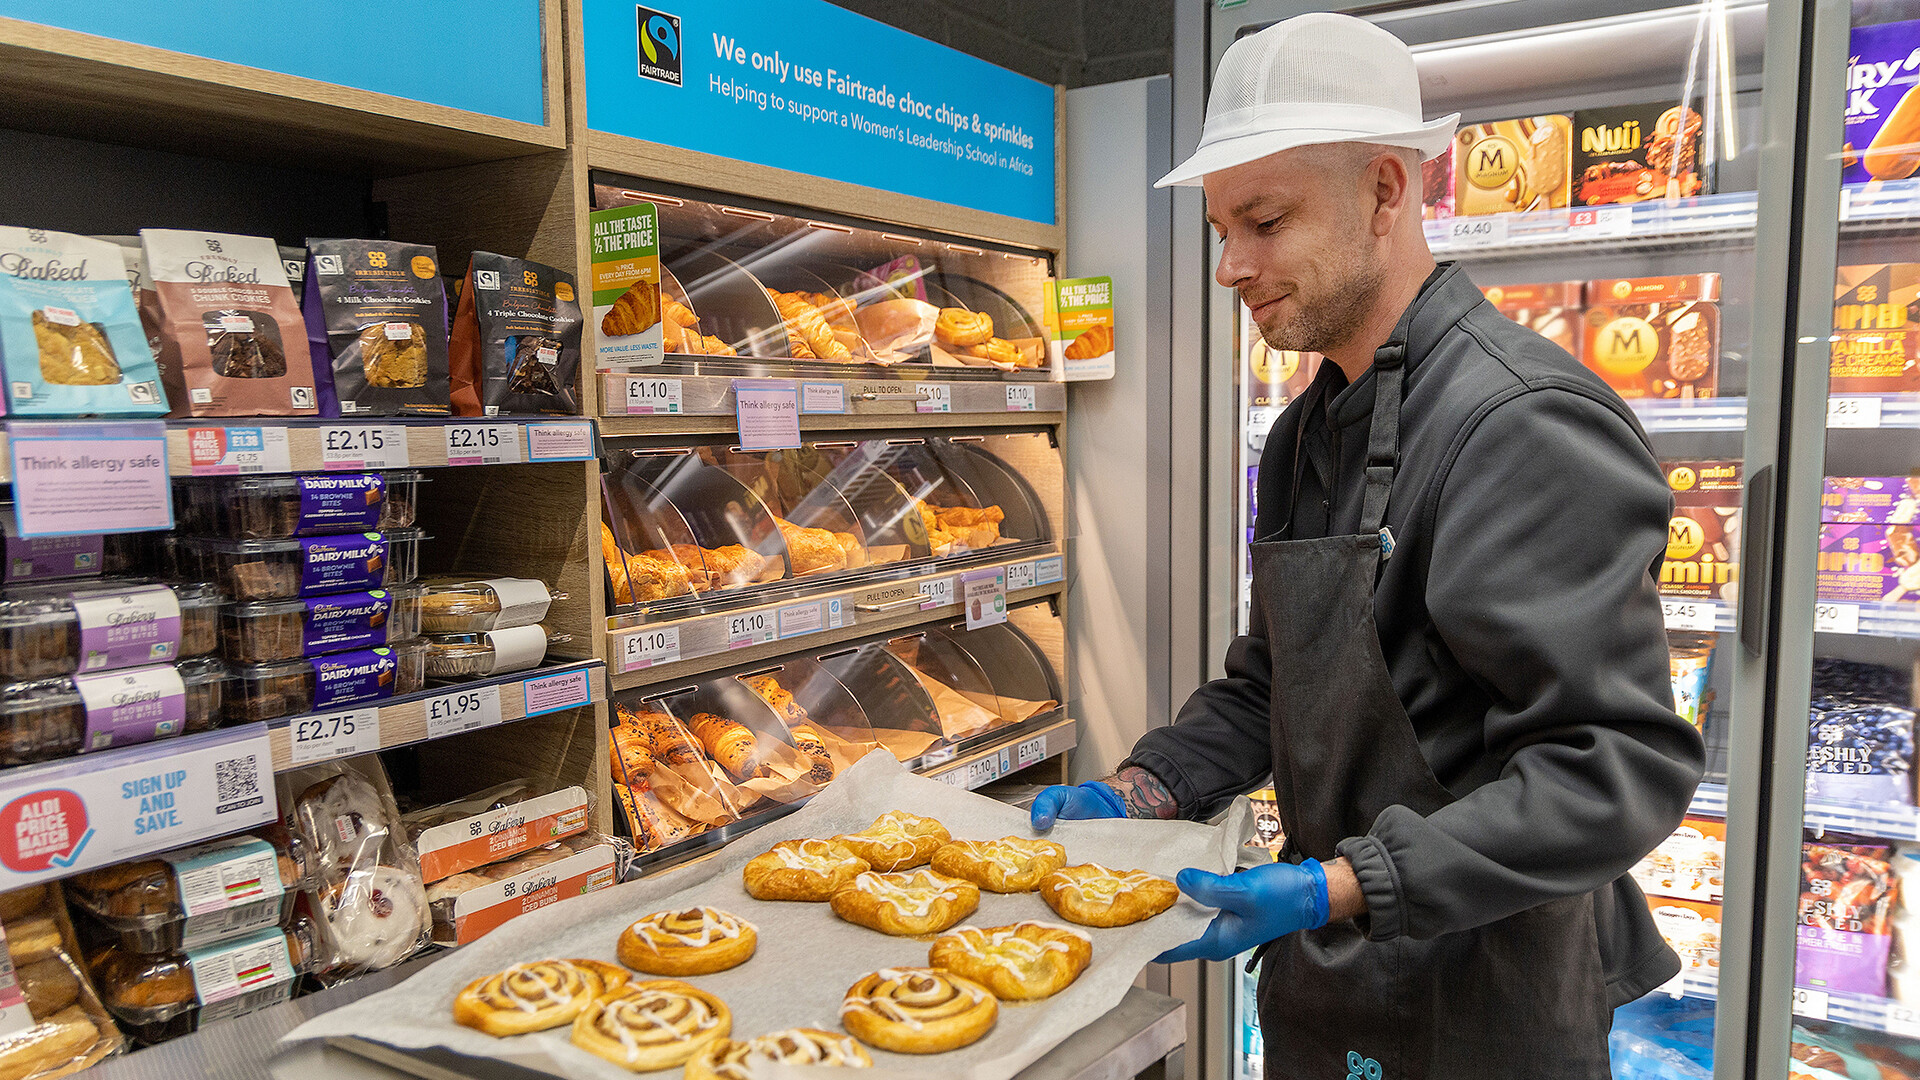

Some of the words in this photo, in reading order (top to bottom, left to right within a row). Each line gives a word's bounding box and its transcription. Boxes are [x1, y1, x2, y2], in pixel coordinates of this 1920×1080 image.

[641, 63, 679, 82] FAIRTRADE
[712, 32, 746, 65] We
[751, 51, 790, 84] only
[794, 64, 823, 88] use
[827, 68, 896, 109] Fairtrade
[899, 94, 932, 120] choc
[935, 103, 969, 131] chips
[972, 113, 982, 135] &
[984, 118, 1034, 151] sprinkles
[709, 74, 767, 111] Helping
[771, 92, 785, 110] to
[788, 97, 838, 129] support
[840, 113, 848, 128] a
[851, 112, 904, 142] Women's
[907, 127, 963, 160] Leadership
[966, 144, 997, 167] School
[999, 152, 1008, 169] in
[1009, 155, 1033, 176] Africa
[1479, 149, 1503, 171] M
[1476, 170, 1509, 178] MAGNUM
[594, 222, 609, 237] ALL
[609, 219, 625, 234] THE
[626, 214, 652, 232] TASTE
[1574, 212, 1592, 225] £3
[1454, 222, 1492, 236] £4.40
[603, 235, 623, 253] THE
[623, 229, 653, 249] PRICE
[0, 252, 88, 281] Baked
[185, 261, 260, 286] Baked
[600, 272, 614, 280] EVERY
[625, 269, 640, 277] FROM
[640, 267, 651, 275] 6PM
[510, 286, 551, 298] IRRESISTIBLE
[1061, 286, 1074, 296] ALL
[1074, 285, 1088, 294] THE
[1088, 283, 1110, 293] TASTE
[1633, 284, 1665, 292] ALMOND
[193, 292, 230, 303] CHUNK
[231, 294, 271, 304] COOKIES
[336, 296, 342, 304] 4
[344, 296, 362, 304] Milk
[363, 296, 402, 304] Chocolate
[403, 297, 432, 305] Cookies
[494, 310, 516, 318] Triple
[517, 311, 548, 320] Chocolate
[1612, 329, 1642, 354] M
[629, 381, 667, 398] £1.10
[863, 386, 877, 394] PULL
[1008, 388, 1028, 400] £1.10
[740, 400, 758, 409] Think
[759, 401, 781, 411] allergy
[782, 400, 795, 409] safe
[195, 431, 215, 440] ALDI
[326, 430, 384, 450] £2.15
[449, 428, 499, 447] £2.15
[552, 430, 572, 438] allergy
[574, 428, 586, 436] safe
[193, 440, 219, 449] PRICE
[21, 457, 67, 470] Think
[71, 456, 125, 472] allergy
[129, 455, 160, 468] safe
[236, 454, 258, 462] £1.75
[1700, 465, 1736, 478] mini
[304, 479, 338, 489] DAIRY
[339, 479, 366, 488] MILK
[309, 544, 337, 554] Cadbury
[309, 551, 343, 563] DAIRY
[342, 548, 368, 560] MILK
[322, 563, 355, 572] BROWNIE
[323, 570, 343, 578] BITES
[1009, 565, 1028, 579] £1.10
[866, 592, 880, 602] PULL
[881, 590, 888, 599] TO
[889, 588, 905, 598] OPEN
[922, 581, 945, 596] £1.10
[312, 610, 347, 621] DAIRY
[346, 606, 372, 617] MILK
[314, 604, 342, 613] Cadbury
[1663, 604, 1696, 617] 5.45
[323, 618, 357, 627] BROWNIE
[324, 625, 345, 633] BITES
[732, 615, 764, 634] £1.10
[107, 623, 158, 638] BROWNIE
[627, 633, 665, 654] £1.10
[320, 663, 348, 673] Cadbury
[321, 668, 354, 681] DAIRY
[353, 664, 379, 676] MILK
[333, 678, 366, 689] BROWNIE
[530, 682, 547, 690] Think
[548, 679, 569, 688] allergy
[569, 675, 582, 683] safe
[335, 686, 354, 695] BITES
[112, 702, 163, 716] BROWNIE
[430, 693, 481, 720] £1.95
[296, 715, 355, 743] £2.75
[1020, 741, 1039, 757] £1.10
[969, 760, 990, 778] £1.10
[122, 779, 162, 800] SIGN
[165, 770, 187, 789] UP
[20, 797, 61, 821] ALDI
[139, 791, 175, 815] AND
[220, 804, 236, 812] SCAN
[15, 811, 68, 838] PRICE
[134, 810, 182, 836] SAVE.
[488, 816, 526, 835] Bakery
[1258, 819, 1278, 832] 360
[18, 828, 70, 850] MATCH
[494, 826, 527, 844] CINNAMON
[489, 842, 507, 853] ICED
[508, 834, 527, 848] BUNS
[522, 875, 557, 896] Bakery
[527, 887, 558, 903] CINNAMON
[522, 903, 538, 913] ICED
[539, 894, 558, 907] BUNS
